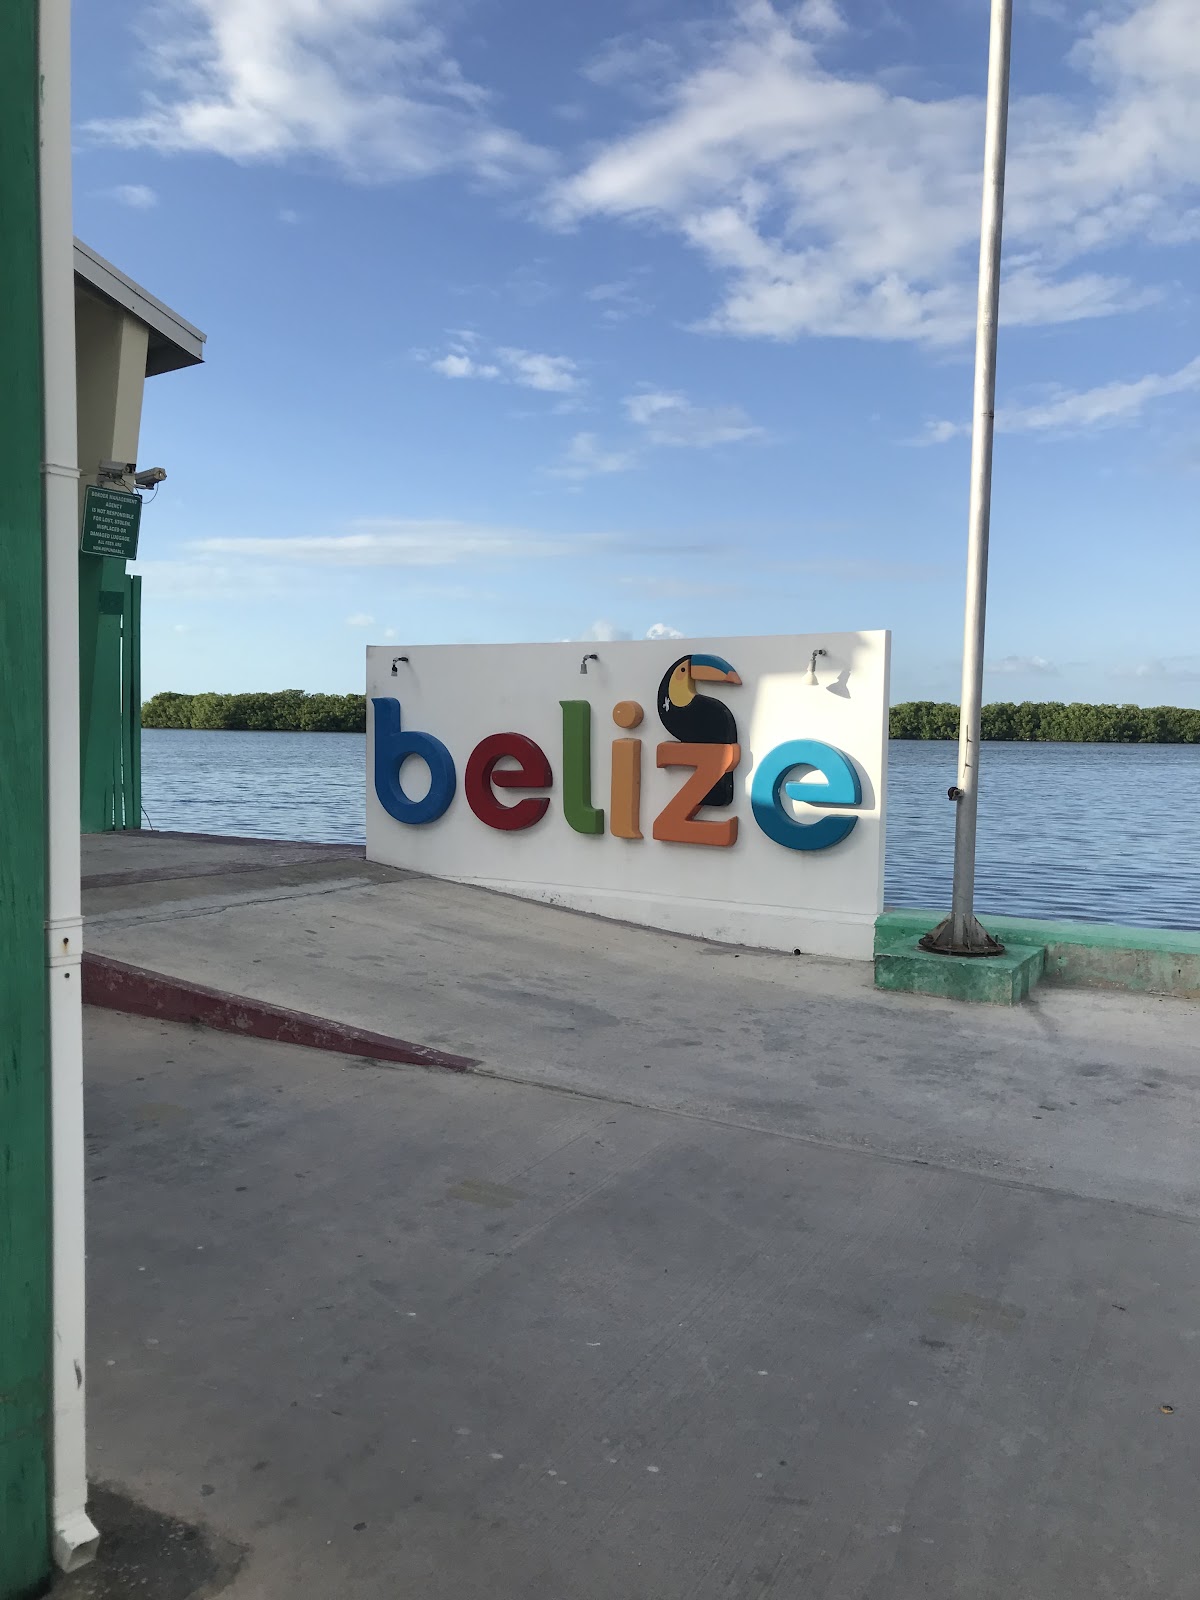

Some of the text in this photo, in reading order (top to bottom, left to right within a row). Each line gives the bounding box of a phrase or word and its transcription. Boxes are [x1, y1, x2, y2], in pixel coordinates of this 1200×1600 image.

[106, 510, 134, 519] RESPONSIBLE
[97, 524, 120, 532] MISPLACED
[371, 697, 862, 851] belize
